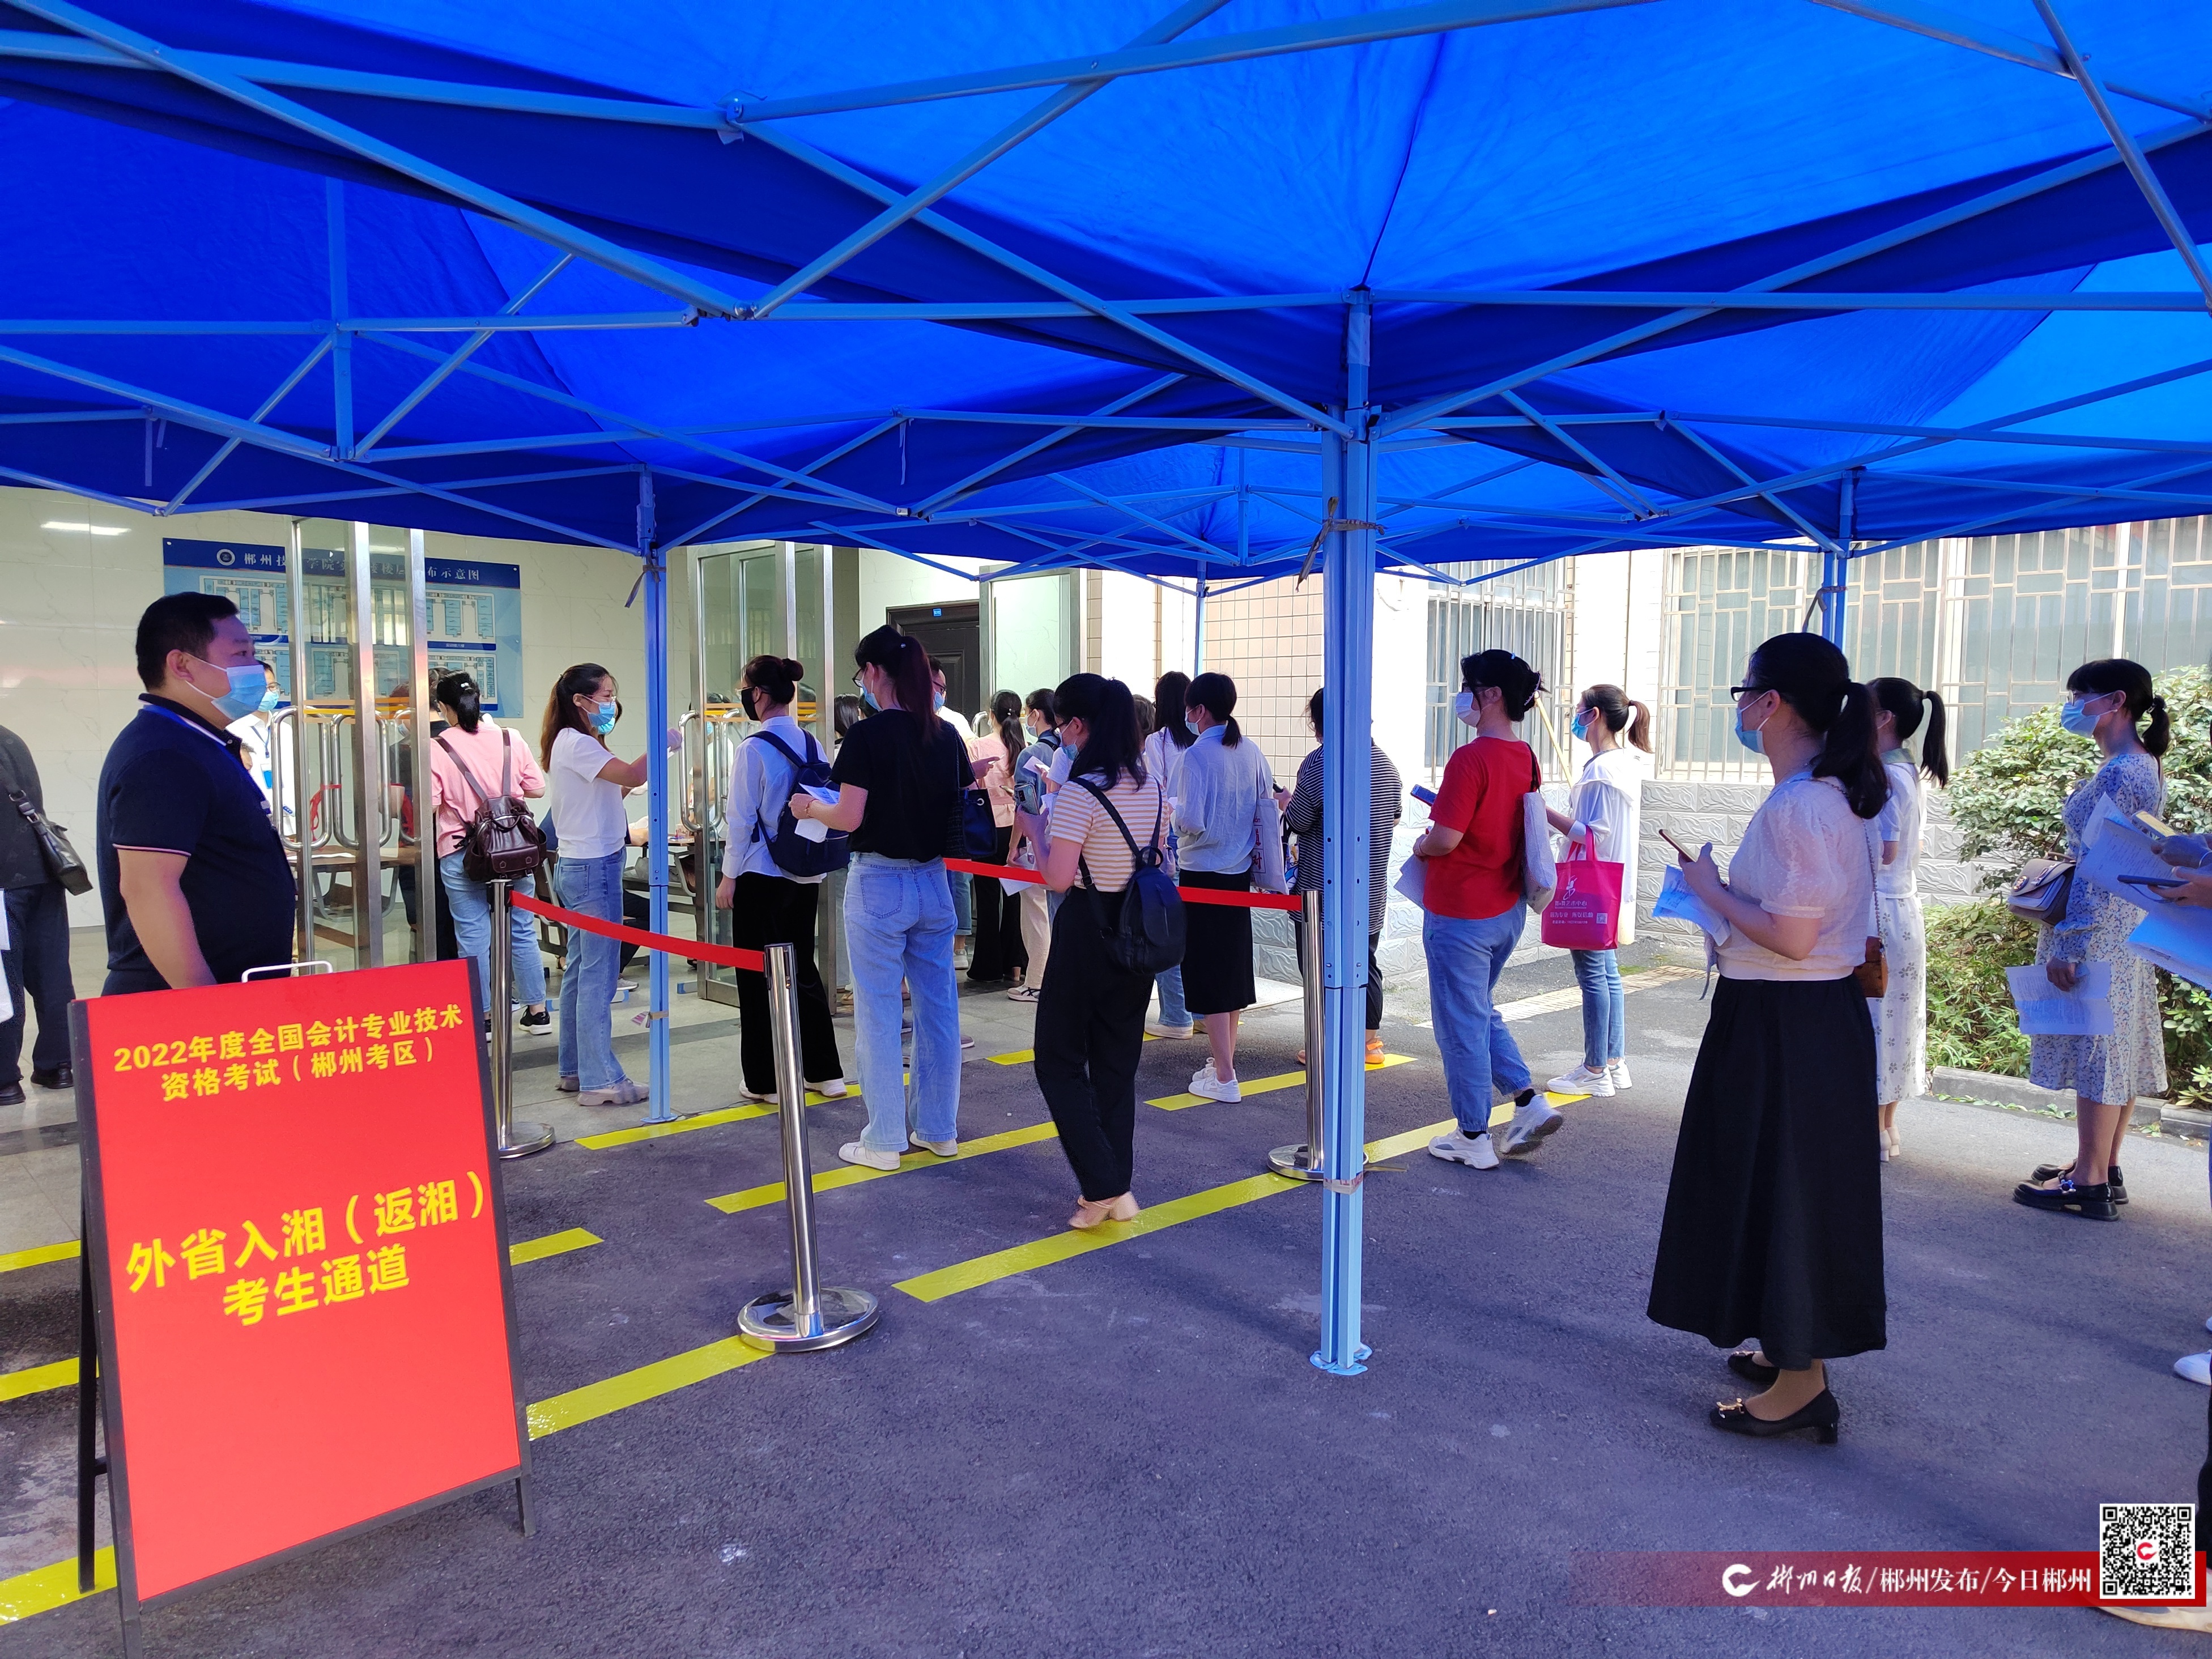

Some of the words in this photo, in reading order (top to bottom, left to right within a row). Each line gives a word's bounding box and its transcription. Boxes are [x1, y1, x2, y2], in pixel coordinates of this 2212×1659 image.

[114, 1004, 463, 1071] 2022年度全国会计专业技术
[161, 1037, 433, 1101] 资格考试（郴州考区）
[126, 1171, 484, 1293] 外省入湘（返湘）
[223, 1243, 410, 1326] 考生通道
